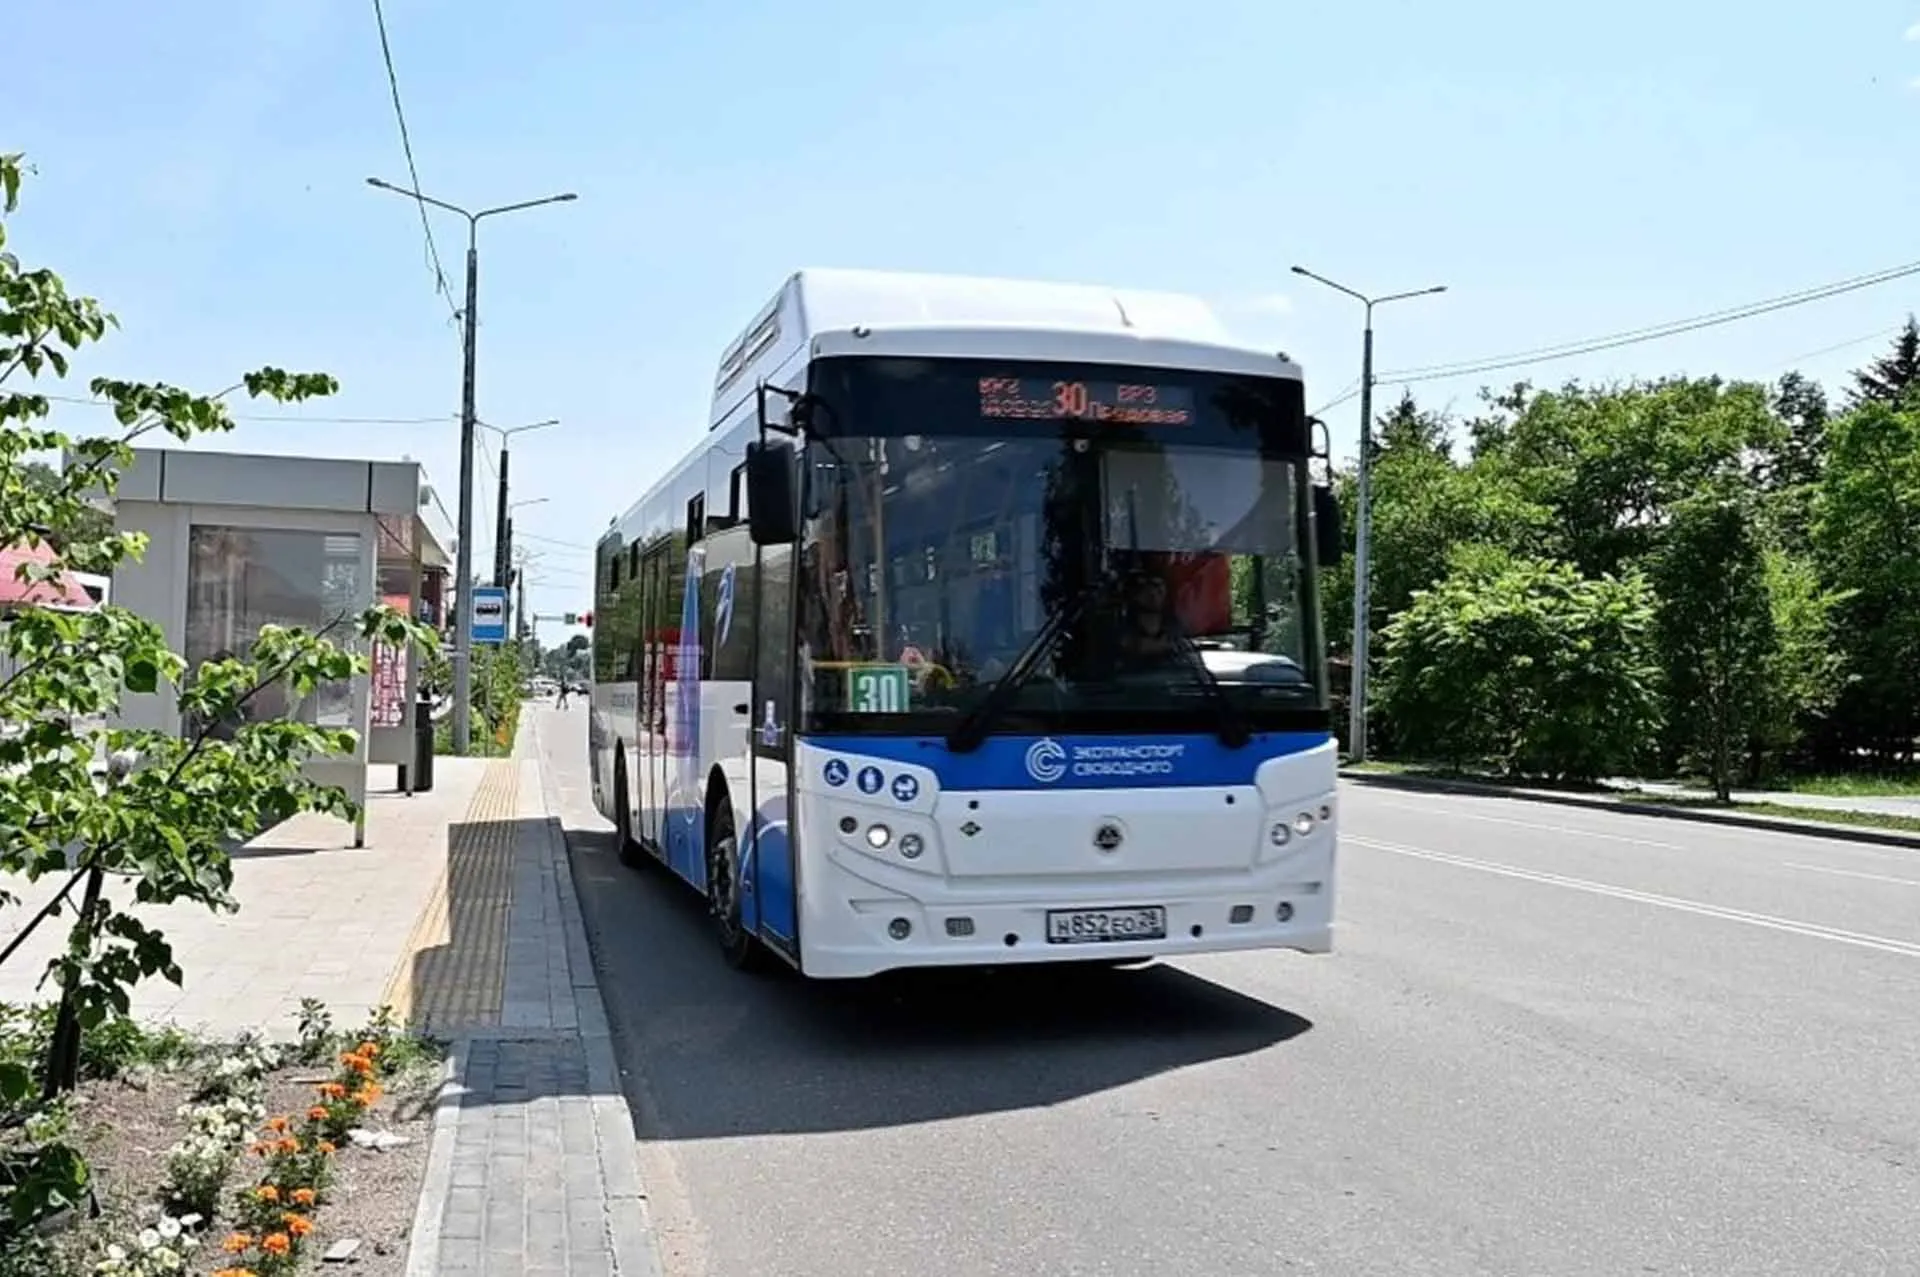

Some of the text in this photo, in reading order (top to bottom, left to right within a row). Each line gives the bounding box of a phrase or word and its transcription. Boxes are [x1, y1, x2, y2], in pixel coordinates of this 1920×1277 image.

[1053, 381, 1087, 415] 30
[858, 674, 898, 712] 30
[1073, 745, 1184, 759] ЭКОТРАНСПОРТ
[1073, 761, 1173, 776] СВОБОДНОГО
